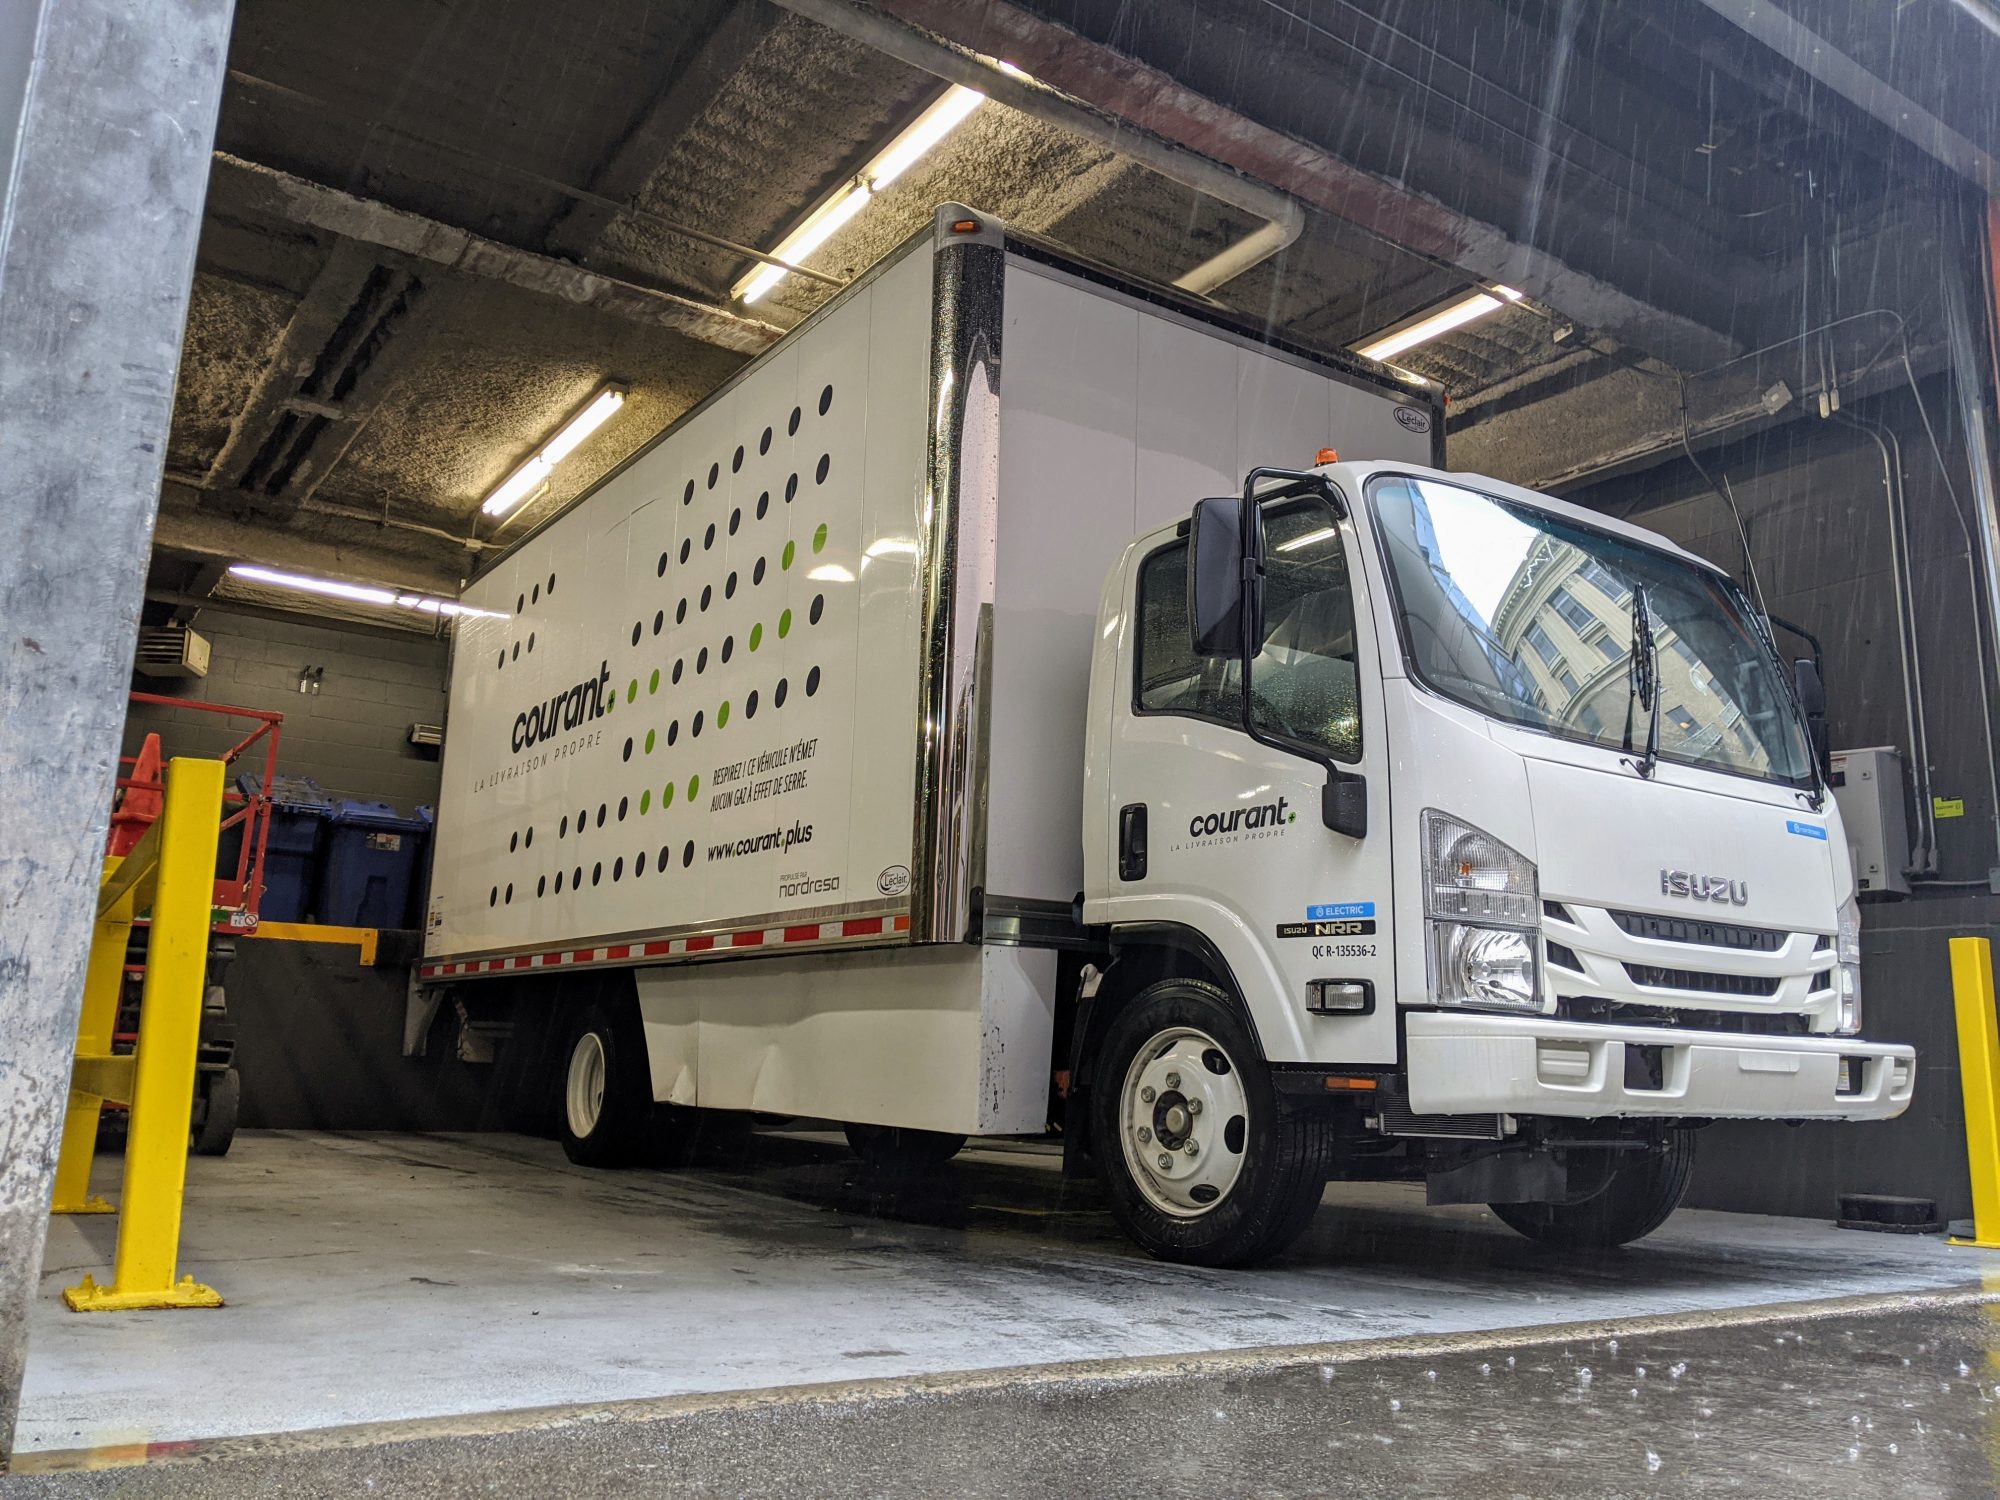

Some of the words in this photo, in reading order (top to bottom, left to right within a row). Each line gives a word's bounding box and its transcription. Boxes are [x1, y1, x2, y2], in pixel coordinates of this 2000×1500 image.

[474, 779, 484, 793] LA
[489, 753, 547, 787] LIVRAISON
[554, 730, 602, 762] PROPRE
[712, 762, 742, 786] RESPIREZ
[747, 758, 756, 776] CE
[757, 750, 788, 773] VÉHICULE
[710, 791, 733, 812] AUCUN
[734, 786, 747, 806] GAZ
[753, 779, 773, 801] EFFET
[773, 776, 783, 796] DE
[783, 769, 808, 792] SERRE.
[707, 819, 813, 862] www.courant.plus
[1185, 836, 1238, 850] LIVRAISON
[1245, 829, 1285, 841] PROPRE
[779, 876, 840, 898] nordresa
[1660, 867, 1748, 907] ISUZU
[1325, 905, 1364, 916] ELECTRIC
[1283, 926, 1307, 934] ISUZU
[1315, 922, 1362, 935] NRR
[1312, 945, 1324, 959] QC
[1326, 945, 1377, 957] R-135536-2
